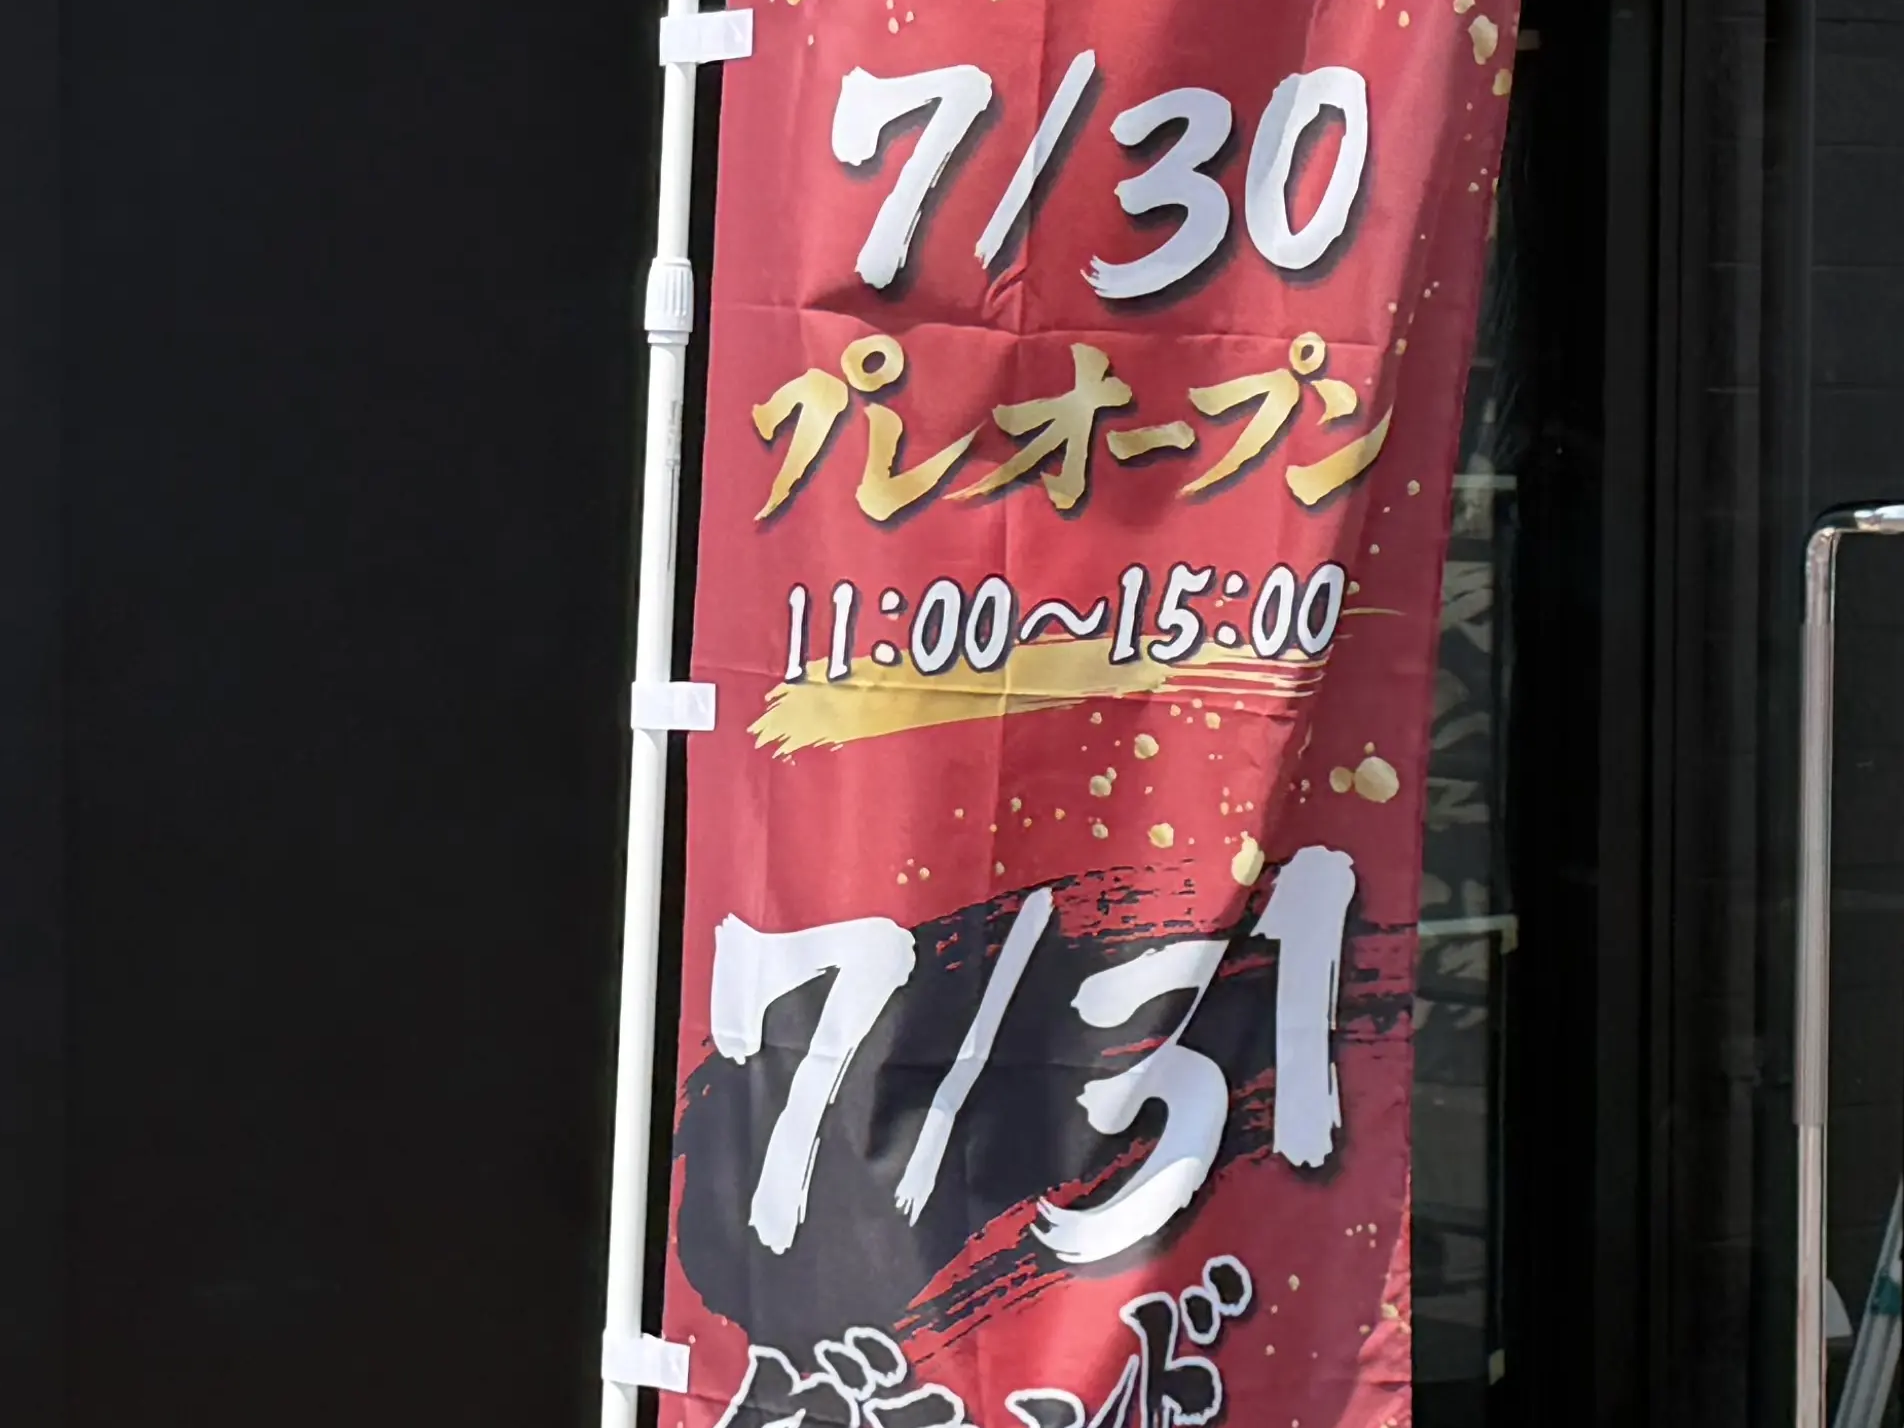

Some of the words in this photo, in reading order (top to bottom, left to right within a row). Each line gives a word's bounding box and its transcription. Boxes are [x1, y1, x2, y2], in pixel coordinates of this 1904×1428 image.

[831, 50, 1370, 300] 7/30
[751, 331, 1394, 524] プレオープン
[710, 843, 1357, 1264] 7/31
